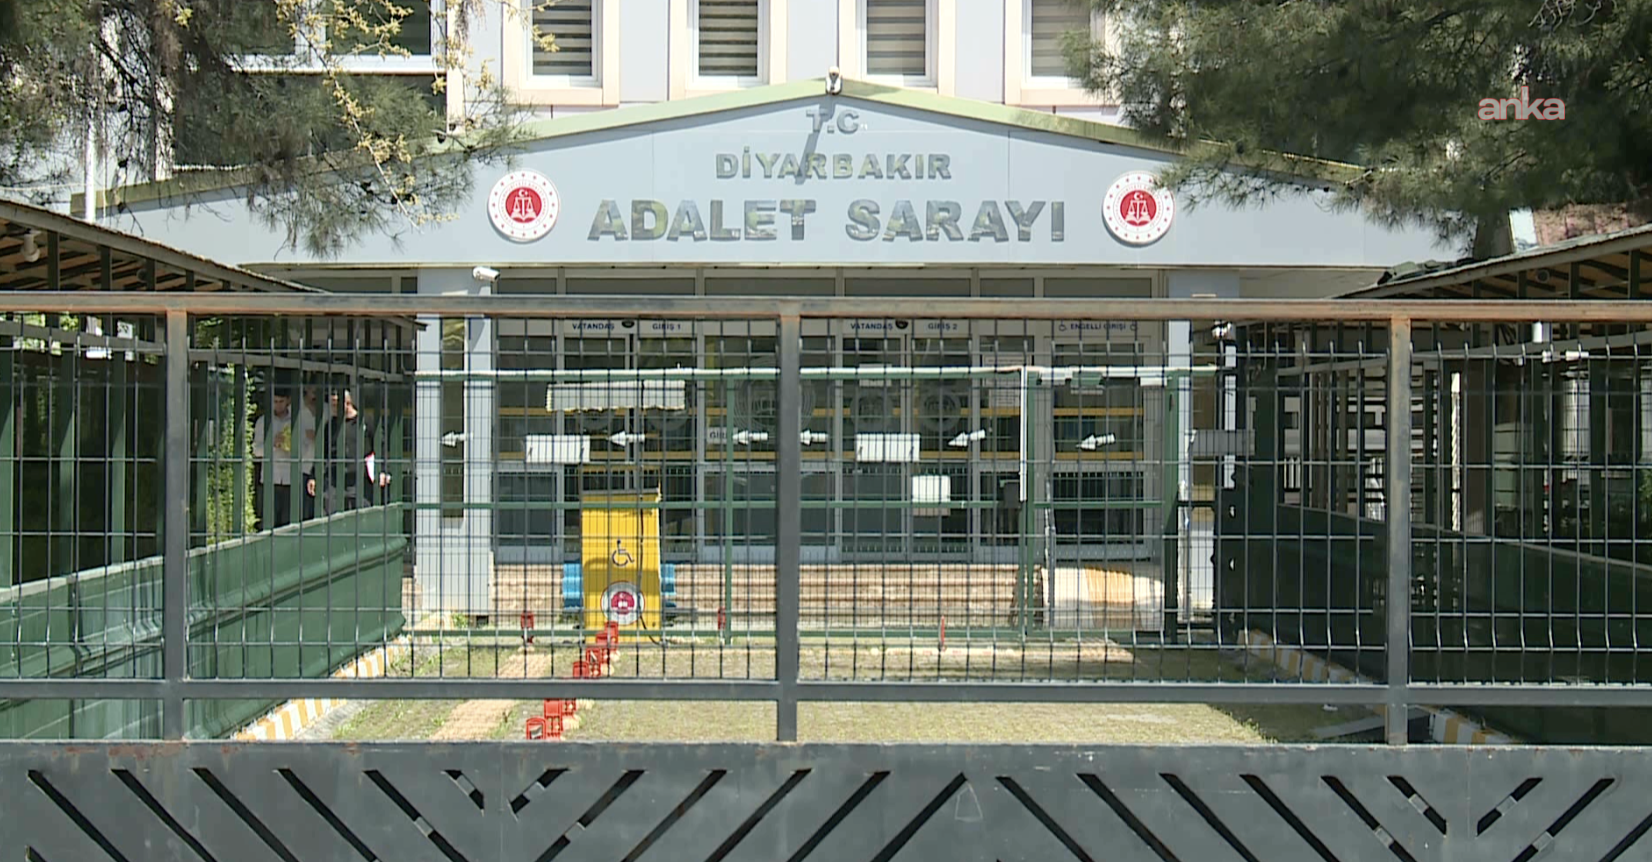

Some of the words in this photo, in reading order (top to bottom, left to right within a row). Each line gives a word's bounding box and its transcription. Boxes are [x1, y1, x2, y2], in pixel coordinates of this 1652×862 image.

[716, 146, 952, 179] DİYARBAKIR
[586, 199, 817, 242] ADALET
[845, 199, 1066, 242] SARAYI
